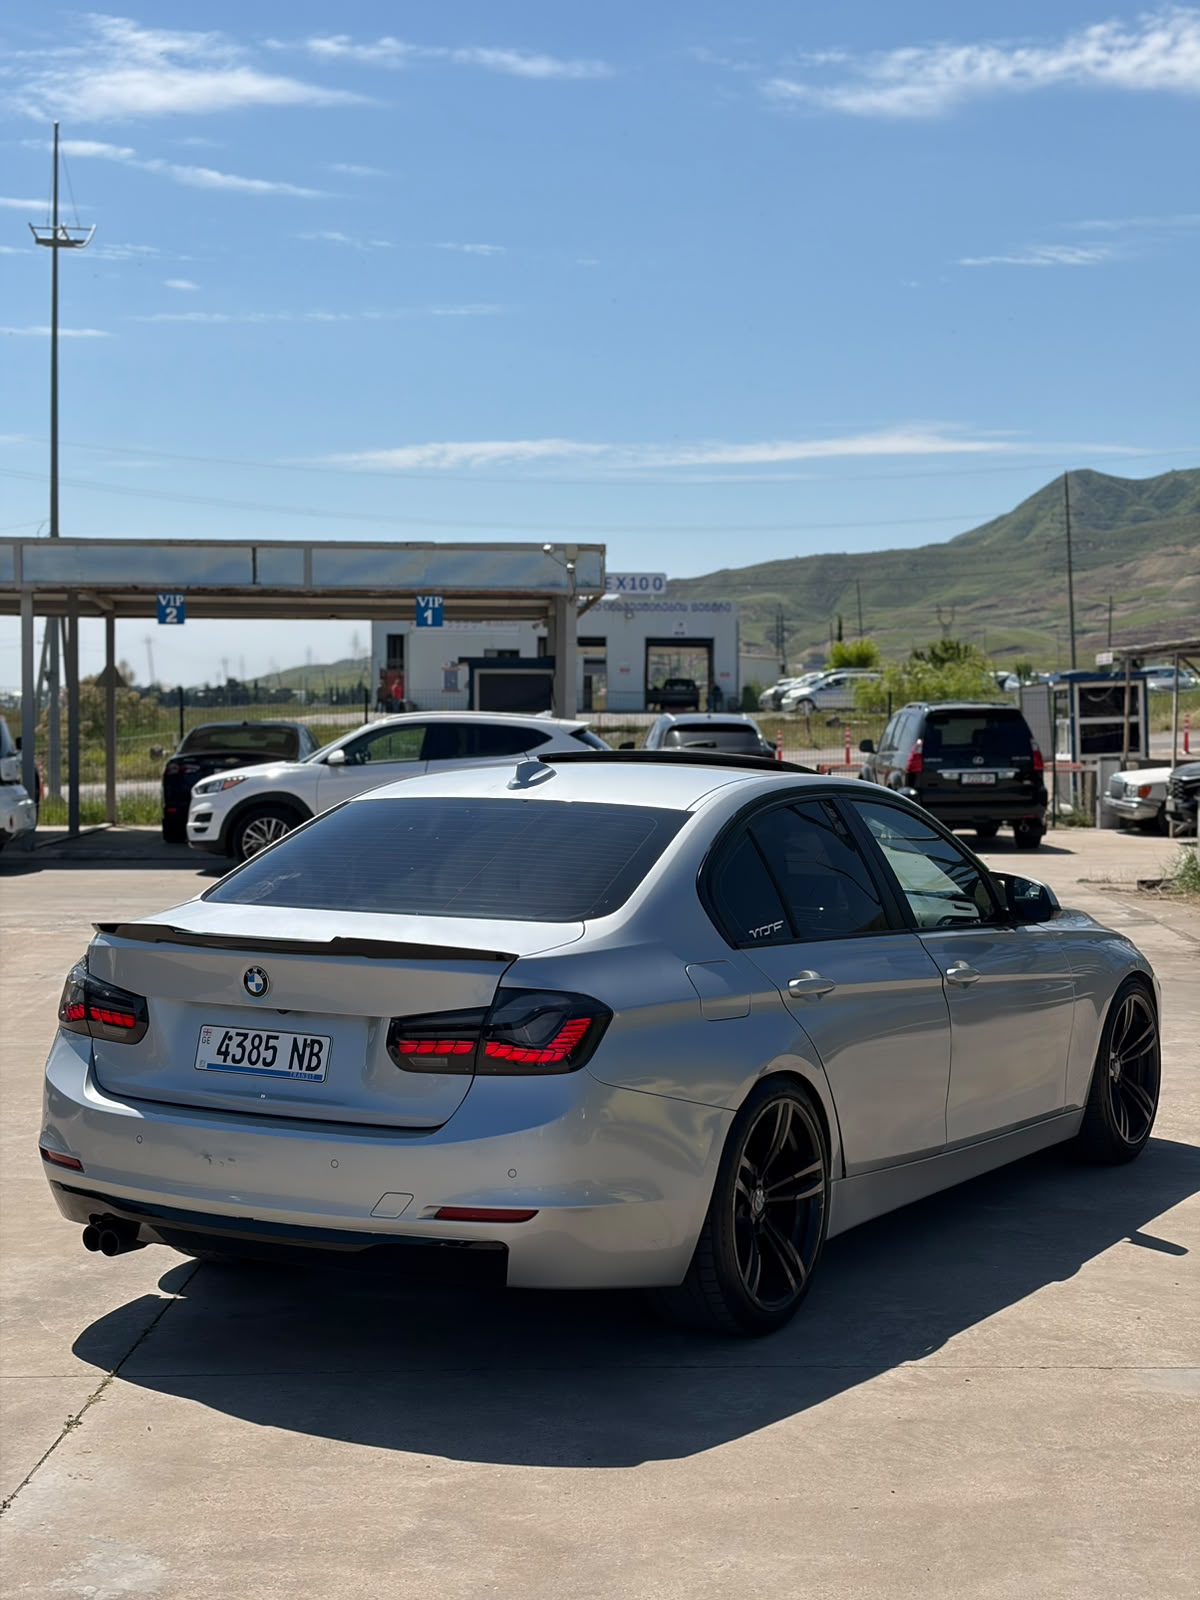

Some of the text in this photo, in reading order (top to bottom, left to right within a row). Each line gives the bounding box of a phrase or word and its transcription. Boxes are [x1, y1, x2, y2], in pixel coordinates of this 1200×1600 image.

[158, 594, 184, 606] VIP
[416, 596, 442, 608] VIP
[165, 607, 177, 623] 2
[423, 609, 433, 625] 1
[202, 1036, 211, 1045] GE
[216, 1030, 324, 1072] 4385 NB
